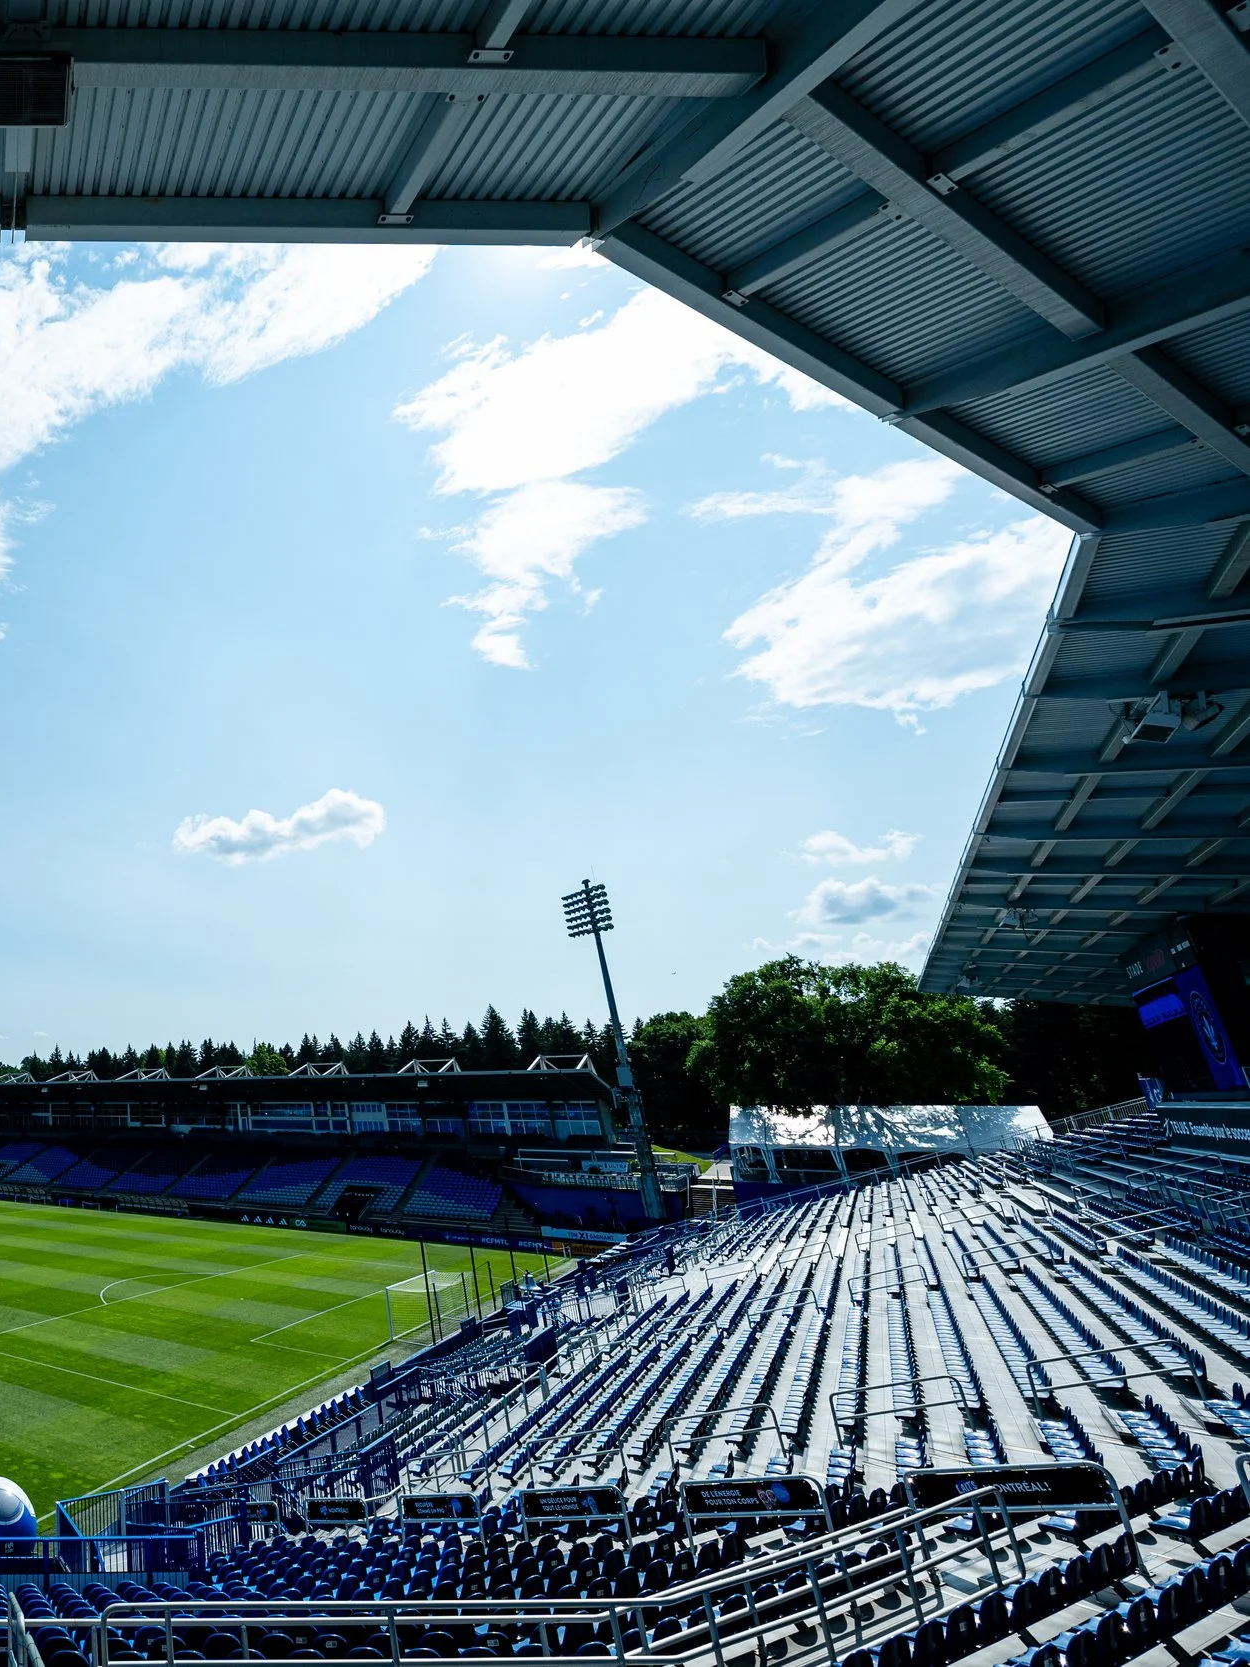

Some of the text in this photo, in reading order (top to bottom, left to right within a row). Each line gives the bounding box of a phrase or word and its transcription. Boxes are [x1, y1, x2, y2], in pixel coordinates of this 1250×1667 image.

[1170, 1121, 1190, 1135] TELUS
[481, 1237, 509, 1245] #CFMTL
[983, 1480, 1052, 1493] ONTRÉAL!
[711, 1489, 742, 1498] L'ÉNERGIE
